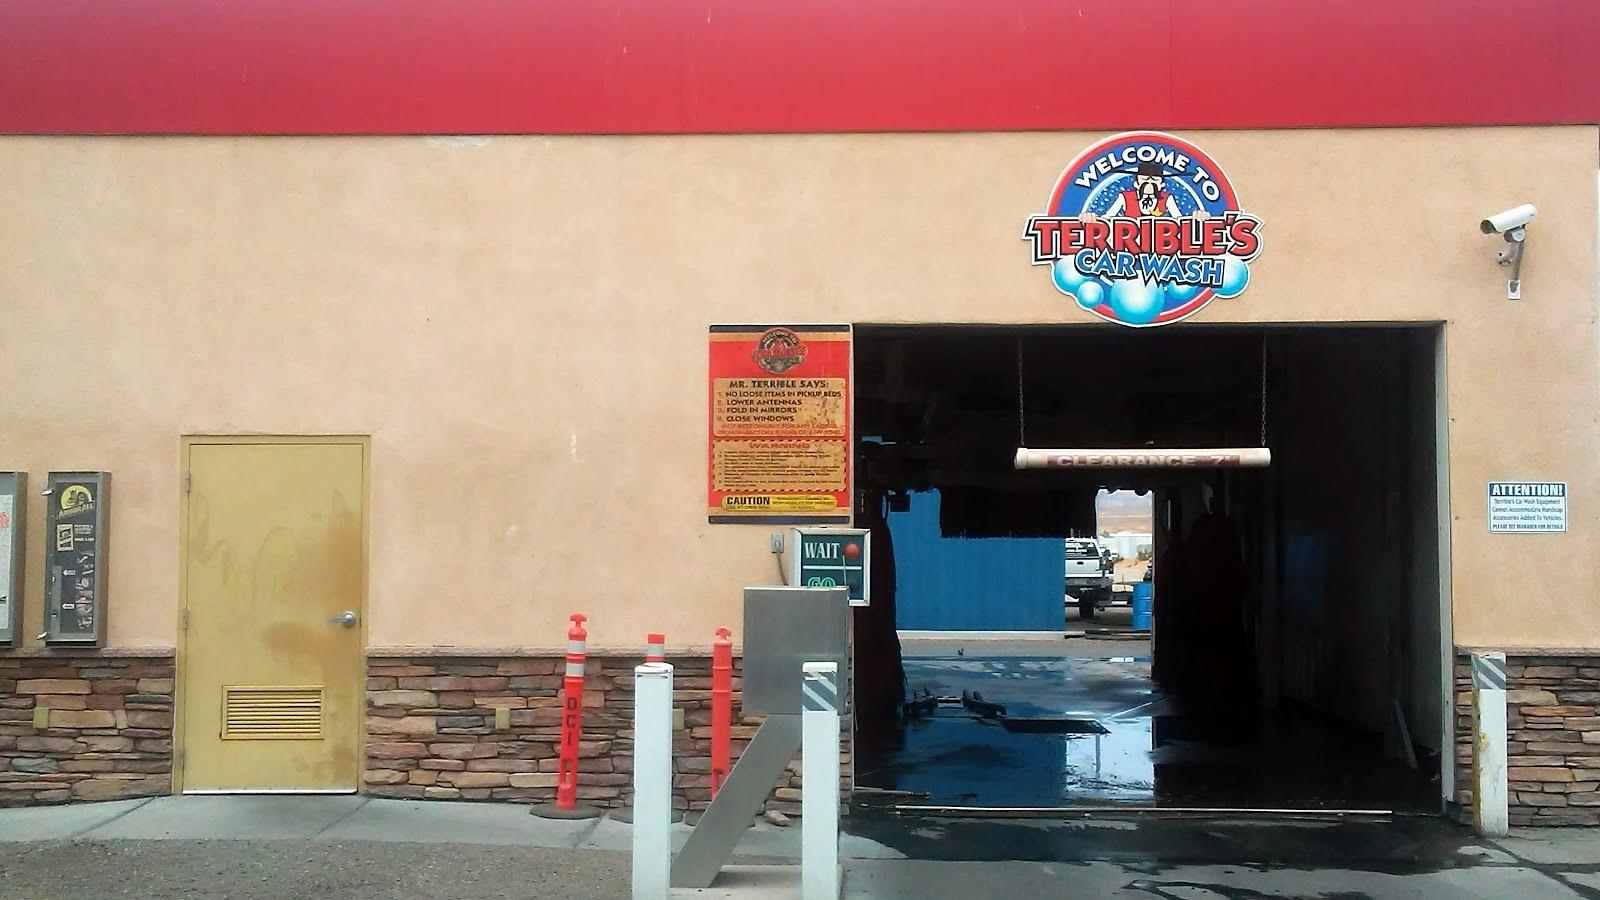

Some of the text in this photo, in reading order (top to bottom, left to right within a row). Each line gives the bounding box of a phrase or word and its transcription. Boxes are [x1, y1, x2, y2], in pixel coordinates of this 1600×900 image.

[1075, 145, 1220, 201] WELCOME TO
[1033, 214, 1258, 256] TERRIBLE'S
[1075, 248, 1226, 288] CAR WASH
[729, 380, 829, 388] MR. TERRIBLE SAYS:
[1056, 454, 1196, 466] CLEARANCE
[1492, 484, 1564, 496] ATTENTION!
[726, 496, 771, 505] CAUTION
[804, 542, 839, 559] WAIT
